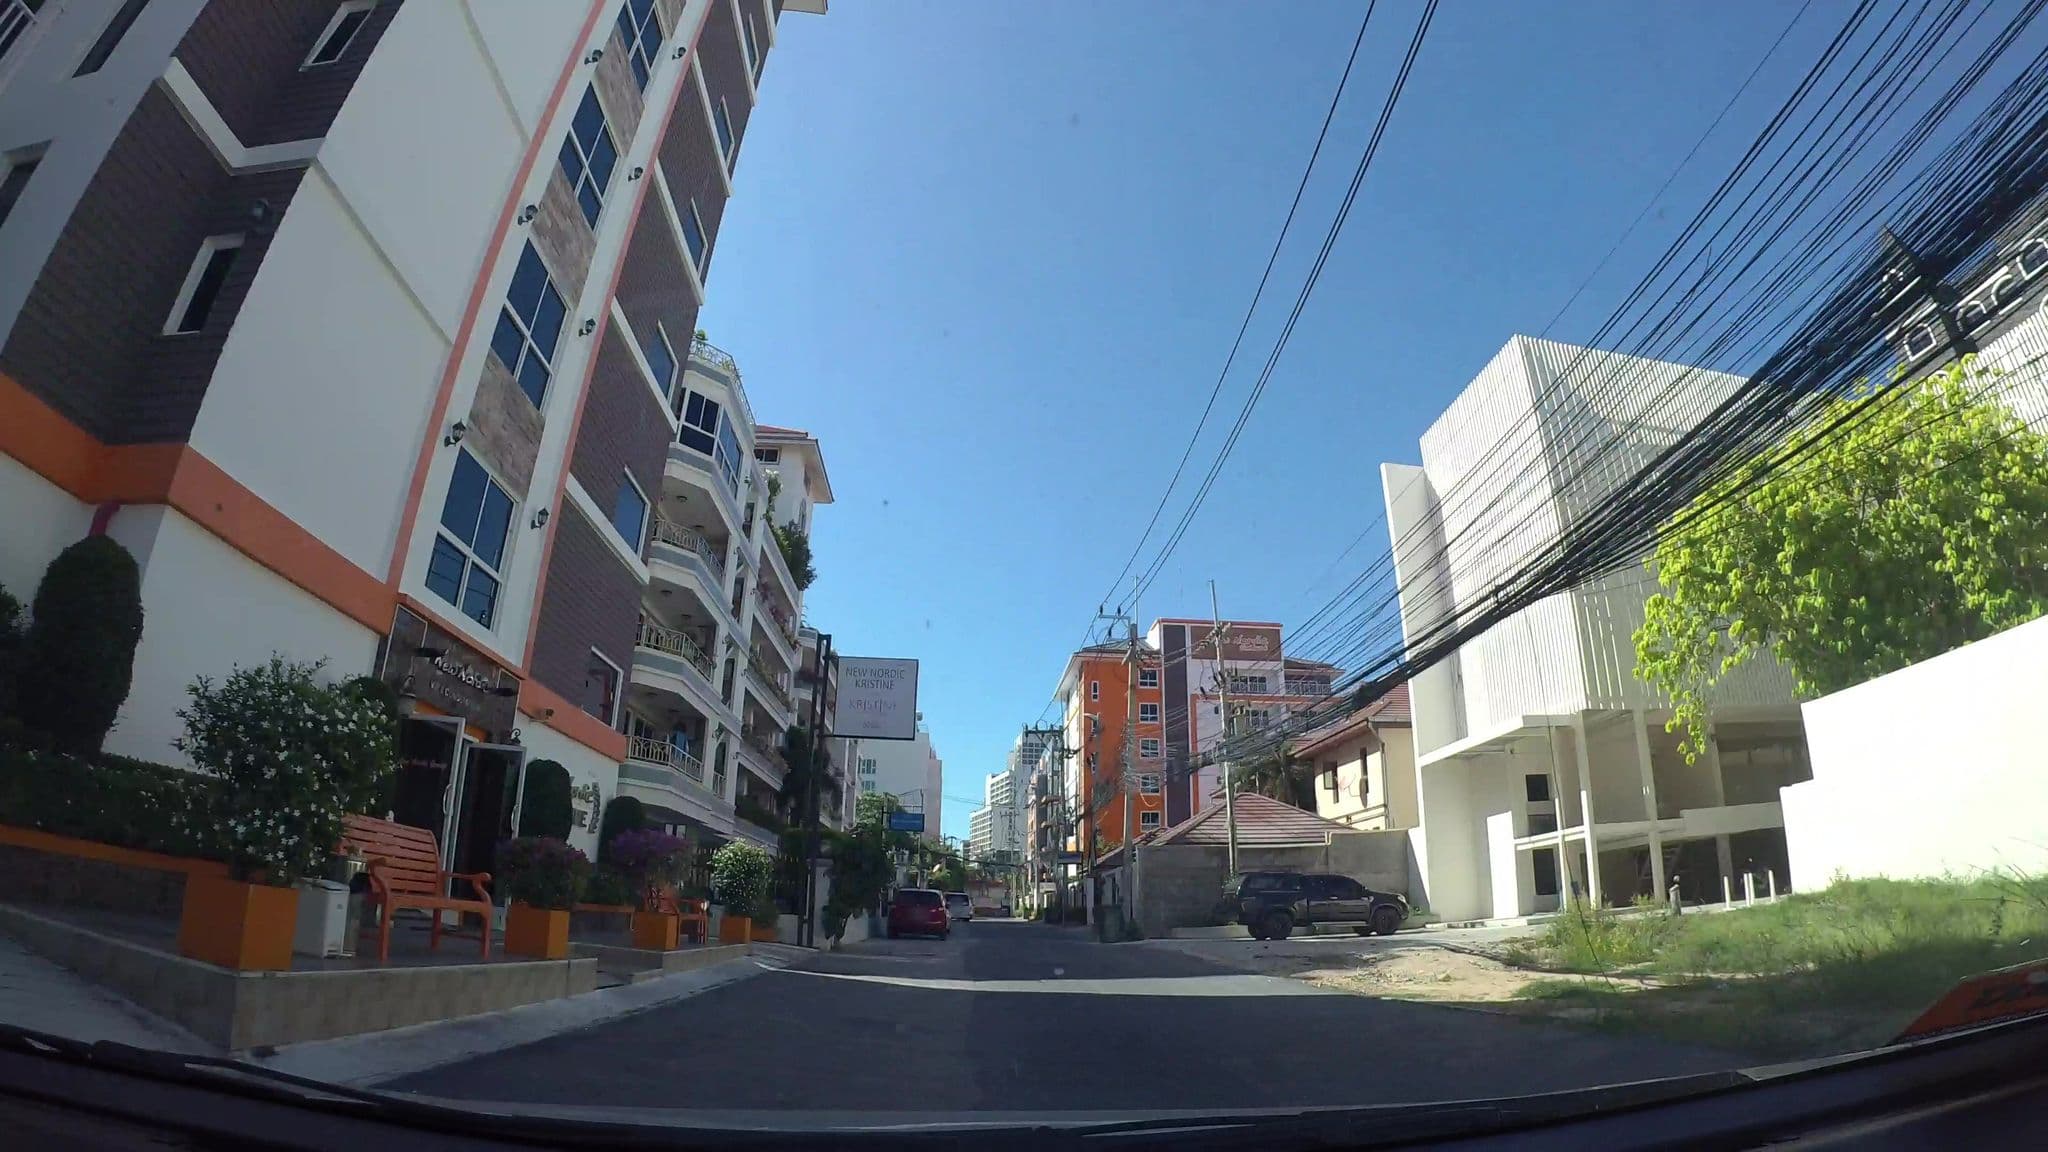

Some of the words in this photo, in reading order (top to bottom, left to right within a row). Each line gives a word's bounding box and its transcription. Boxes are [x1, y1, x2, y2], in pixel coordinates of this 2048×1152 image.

[845, 666, 868, 678] NEW
[870, 668, 906, 680] NORDIC
[855, 679, 896, 690] KRISTINE
